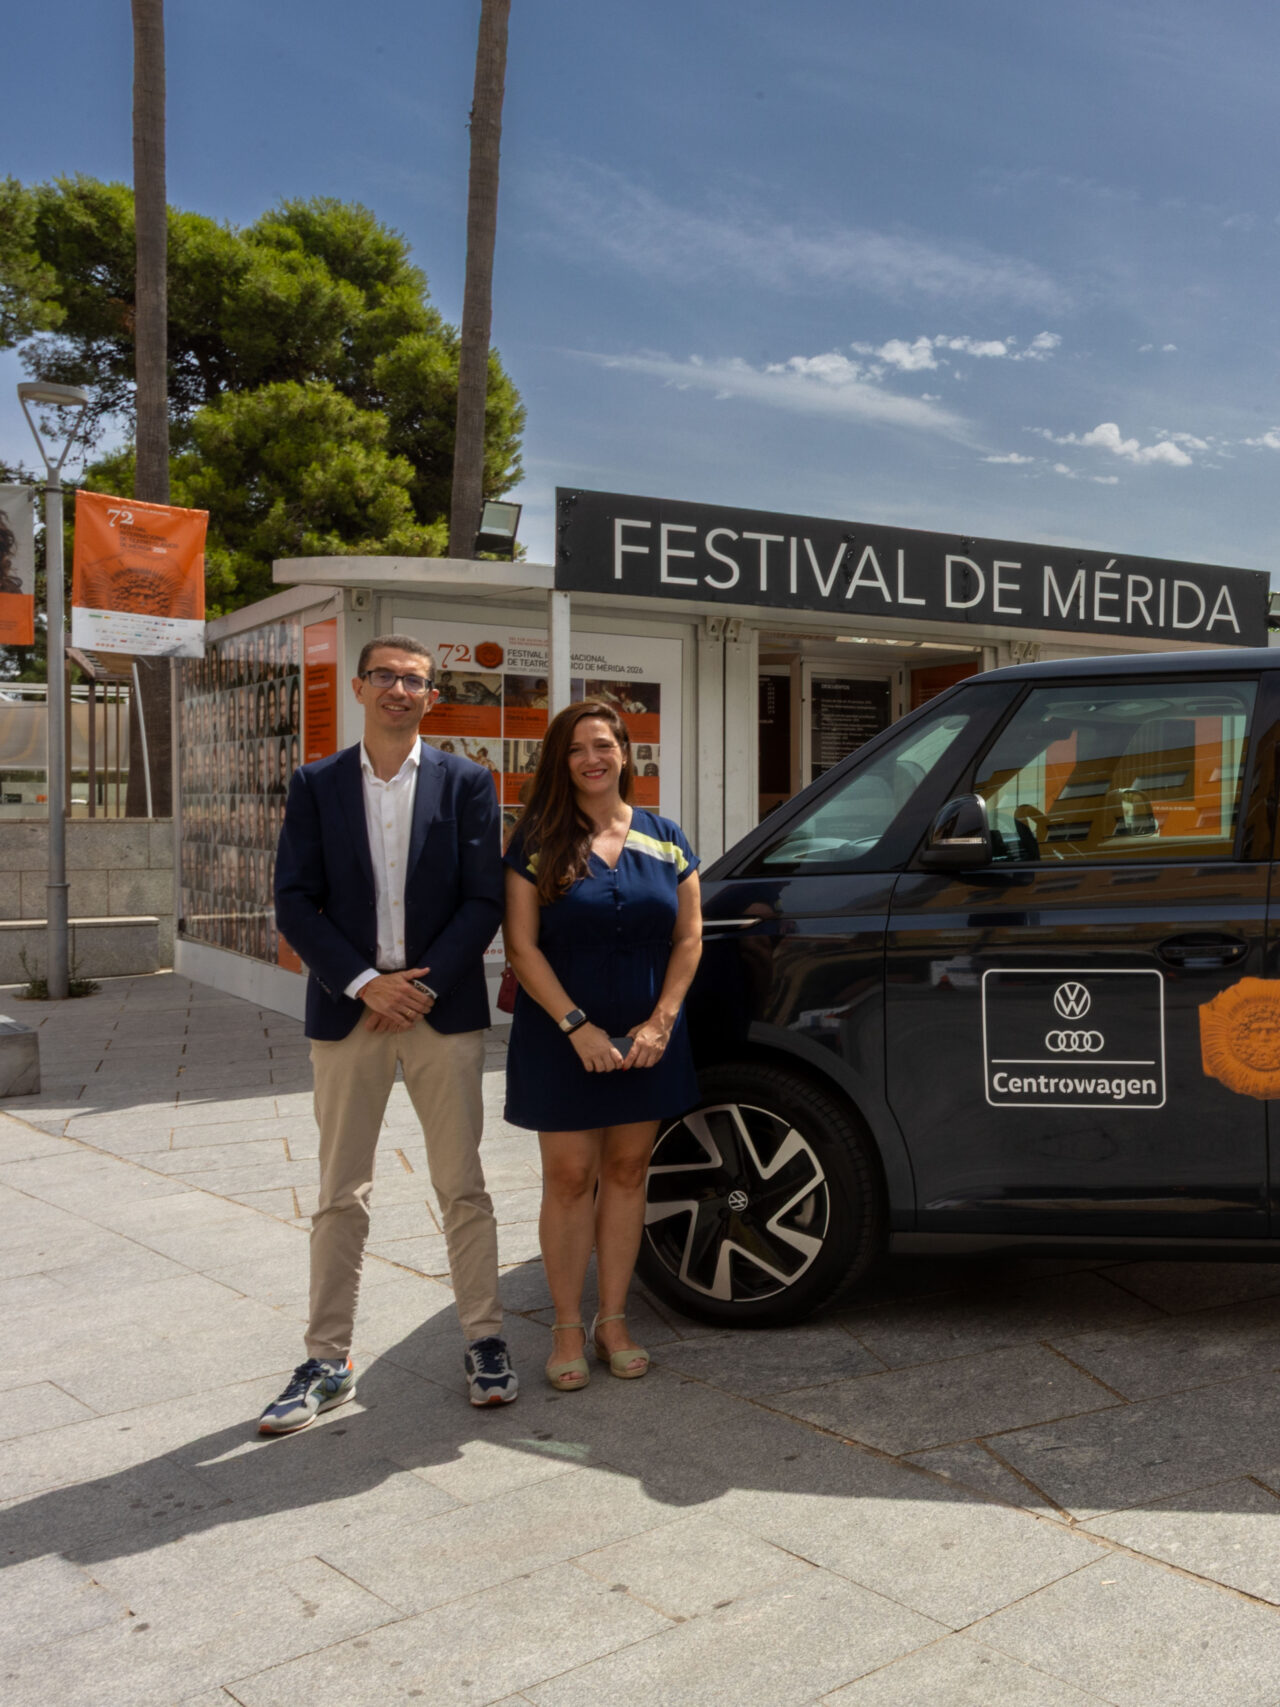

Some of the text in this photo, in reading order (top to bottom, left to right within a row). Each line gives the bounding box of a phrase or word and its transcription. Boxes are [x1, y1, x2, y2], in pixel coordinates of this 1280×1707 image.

[107, 509, 134, 527] 72
[614, 518, 1240, 633] FESTIVAL DE MÉRIDA
[438, 643, 471, 668] 72
[507, 649, 543, 659] FESTIVAL
[507, 658, 518, 666] DE
[596, 663, 625, 672] MÉRIDA
[993, 1072, 1157, 1099] Centrowagen
